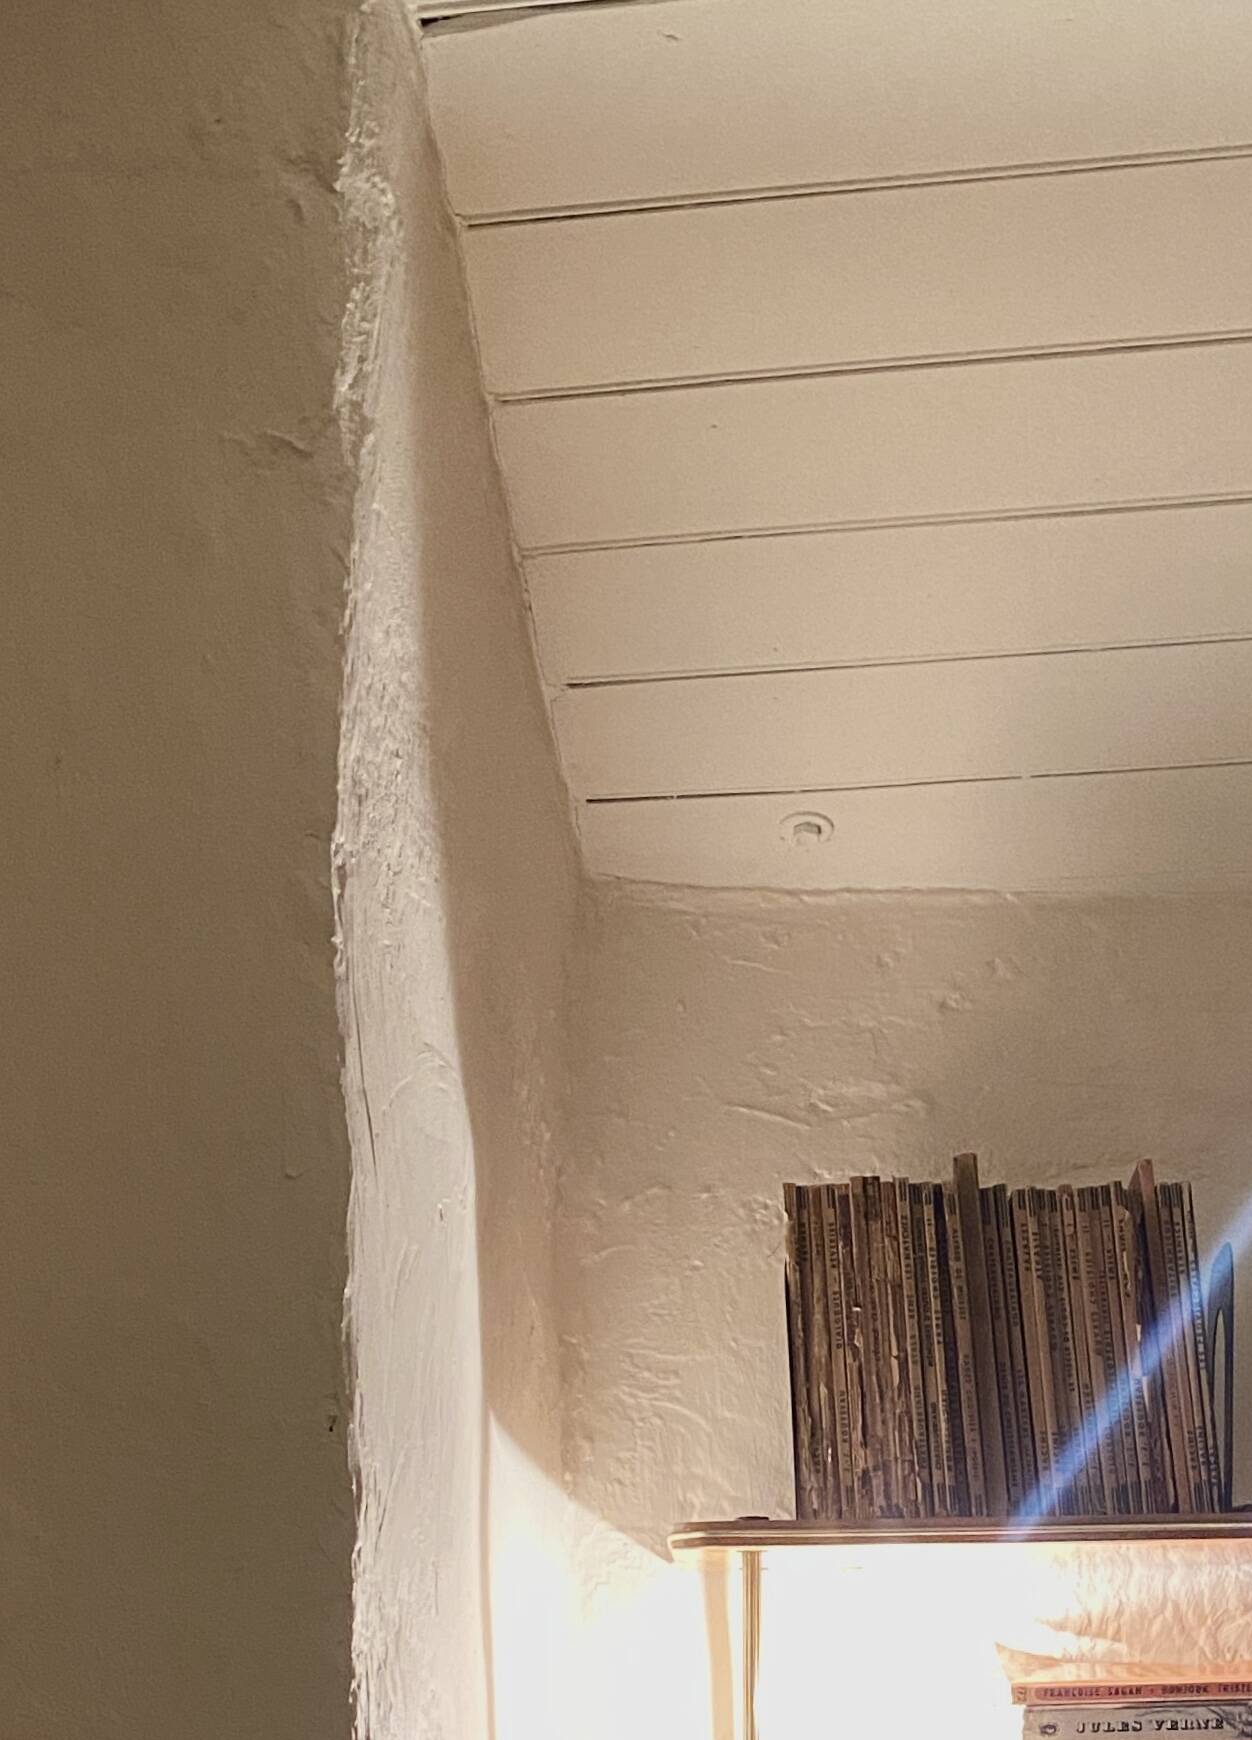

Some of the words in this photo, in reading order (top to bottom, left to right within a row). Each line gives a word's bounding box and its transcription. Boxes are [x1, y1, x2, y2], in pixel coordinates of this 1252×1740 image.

[1107, 1686, 1143, 1696] SAGAN
[1076, 1720, 1143, 1733] JULES
[1153, 1718, 1224, 1731] VERNE
